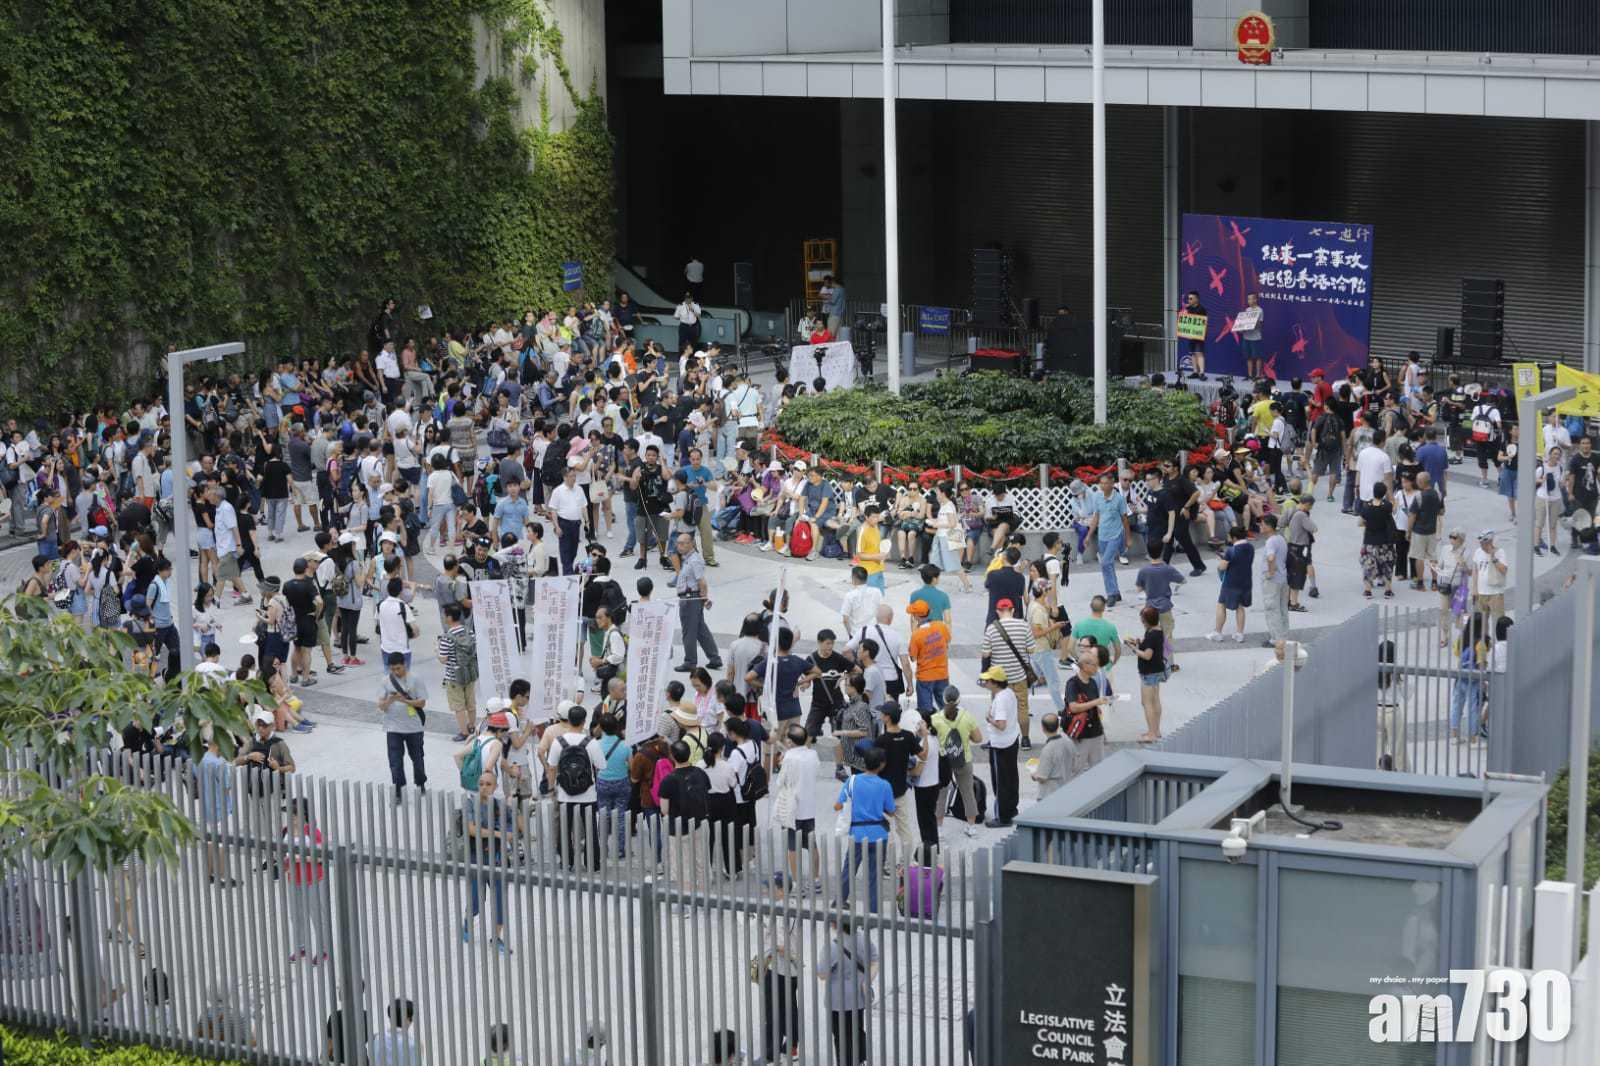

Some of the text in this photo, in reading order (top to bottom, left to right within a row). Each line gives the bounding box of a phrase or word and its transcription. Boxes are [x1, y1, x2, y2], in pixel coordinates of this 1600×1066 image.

[1020, 1010, 1095, 1031] LEGISLATIVE
[1103, 983, 1127, 1066] 立法會
[1037, 1028, 1095, 1047] COUNCIL
[1032, 1044, 1095, 1063] CAR PARK
